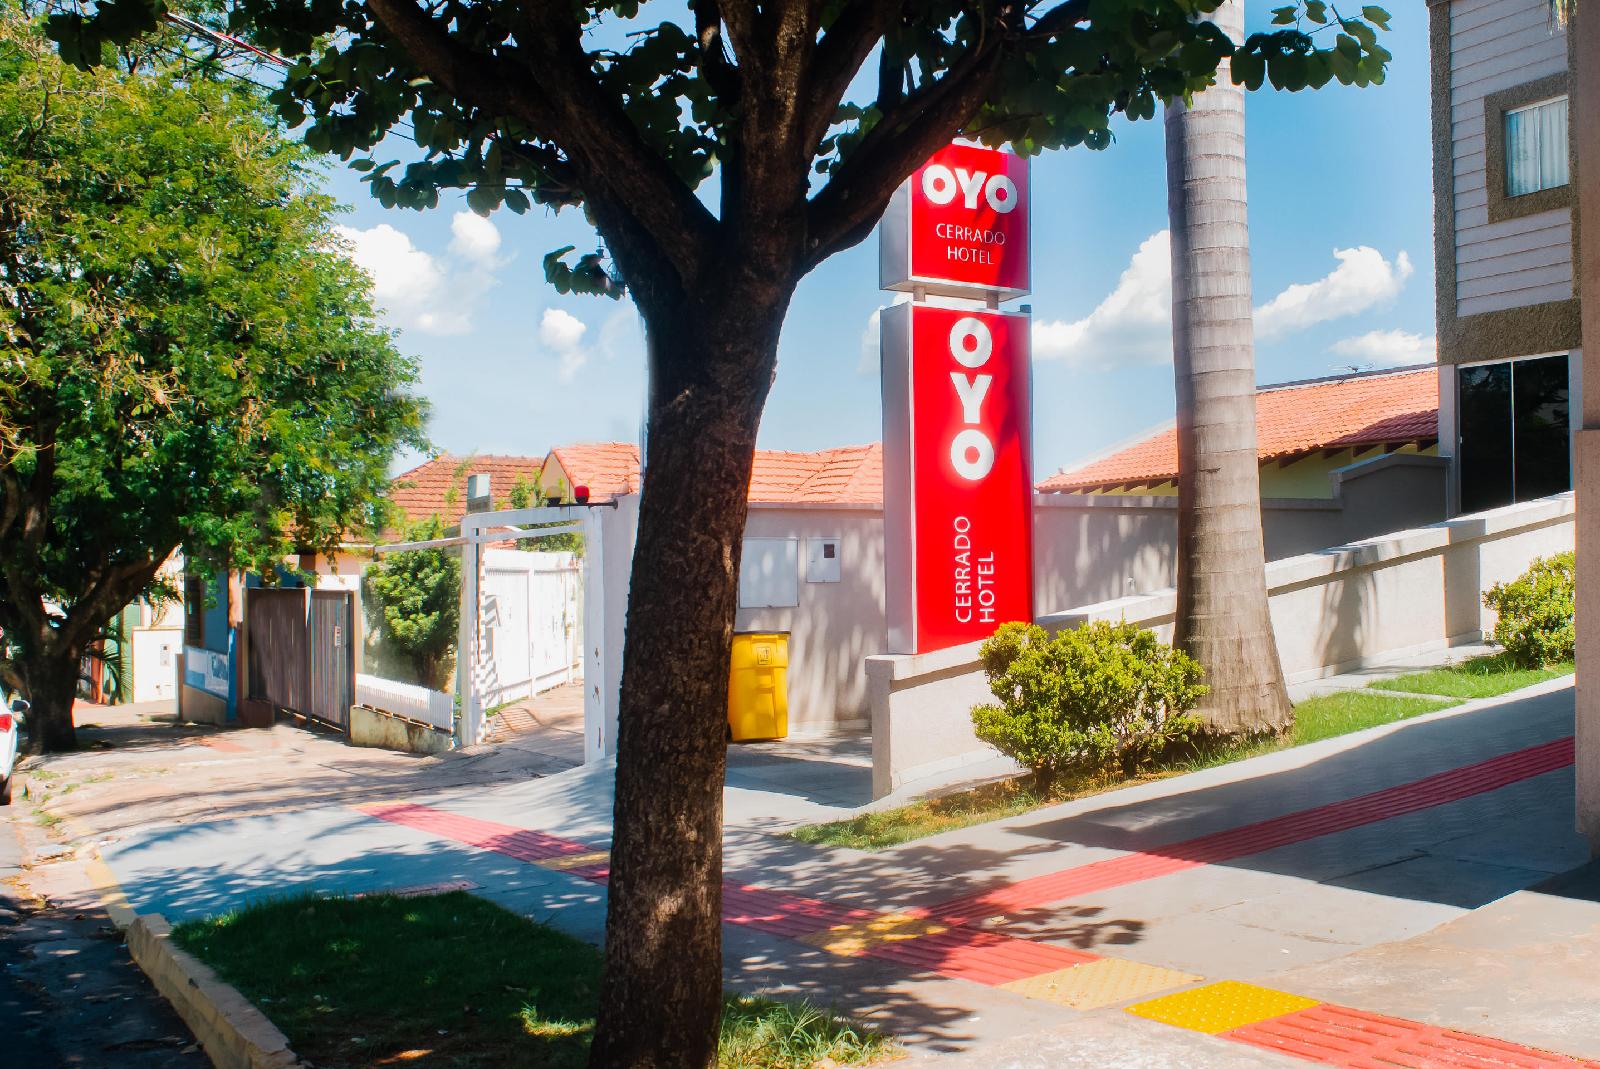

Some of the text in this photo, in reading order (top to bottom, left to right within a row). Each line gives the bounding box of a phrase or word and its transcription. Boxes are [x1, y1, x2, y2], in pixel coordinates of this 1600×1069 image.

[921, 164, 1018, 214] OYO
[935, 223, 1006, 245] CERRADO
[947, 246, 995, 264] HOTEL
[949, 317, 995, 481] OYO
[953, 515, 972, 624] CERRADO
[978, 551, 996, 624] HOTEL
